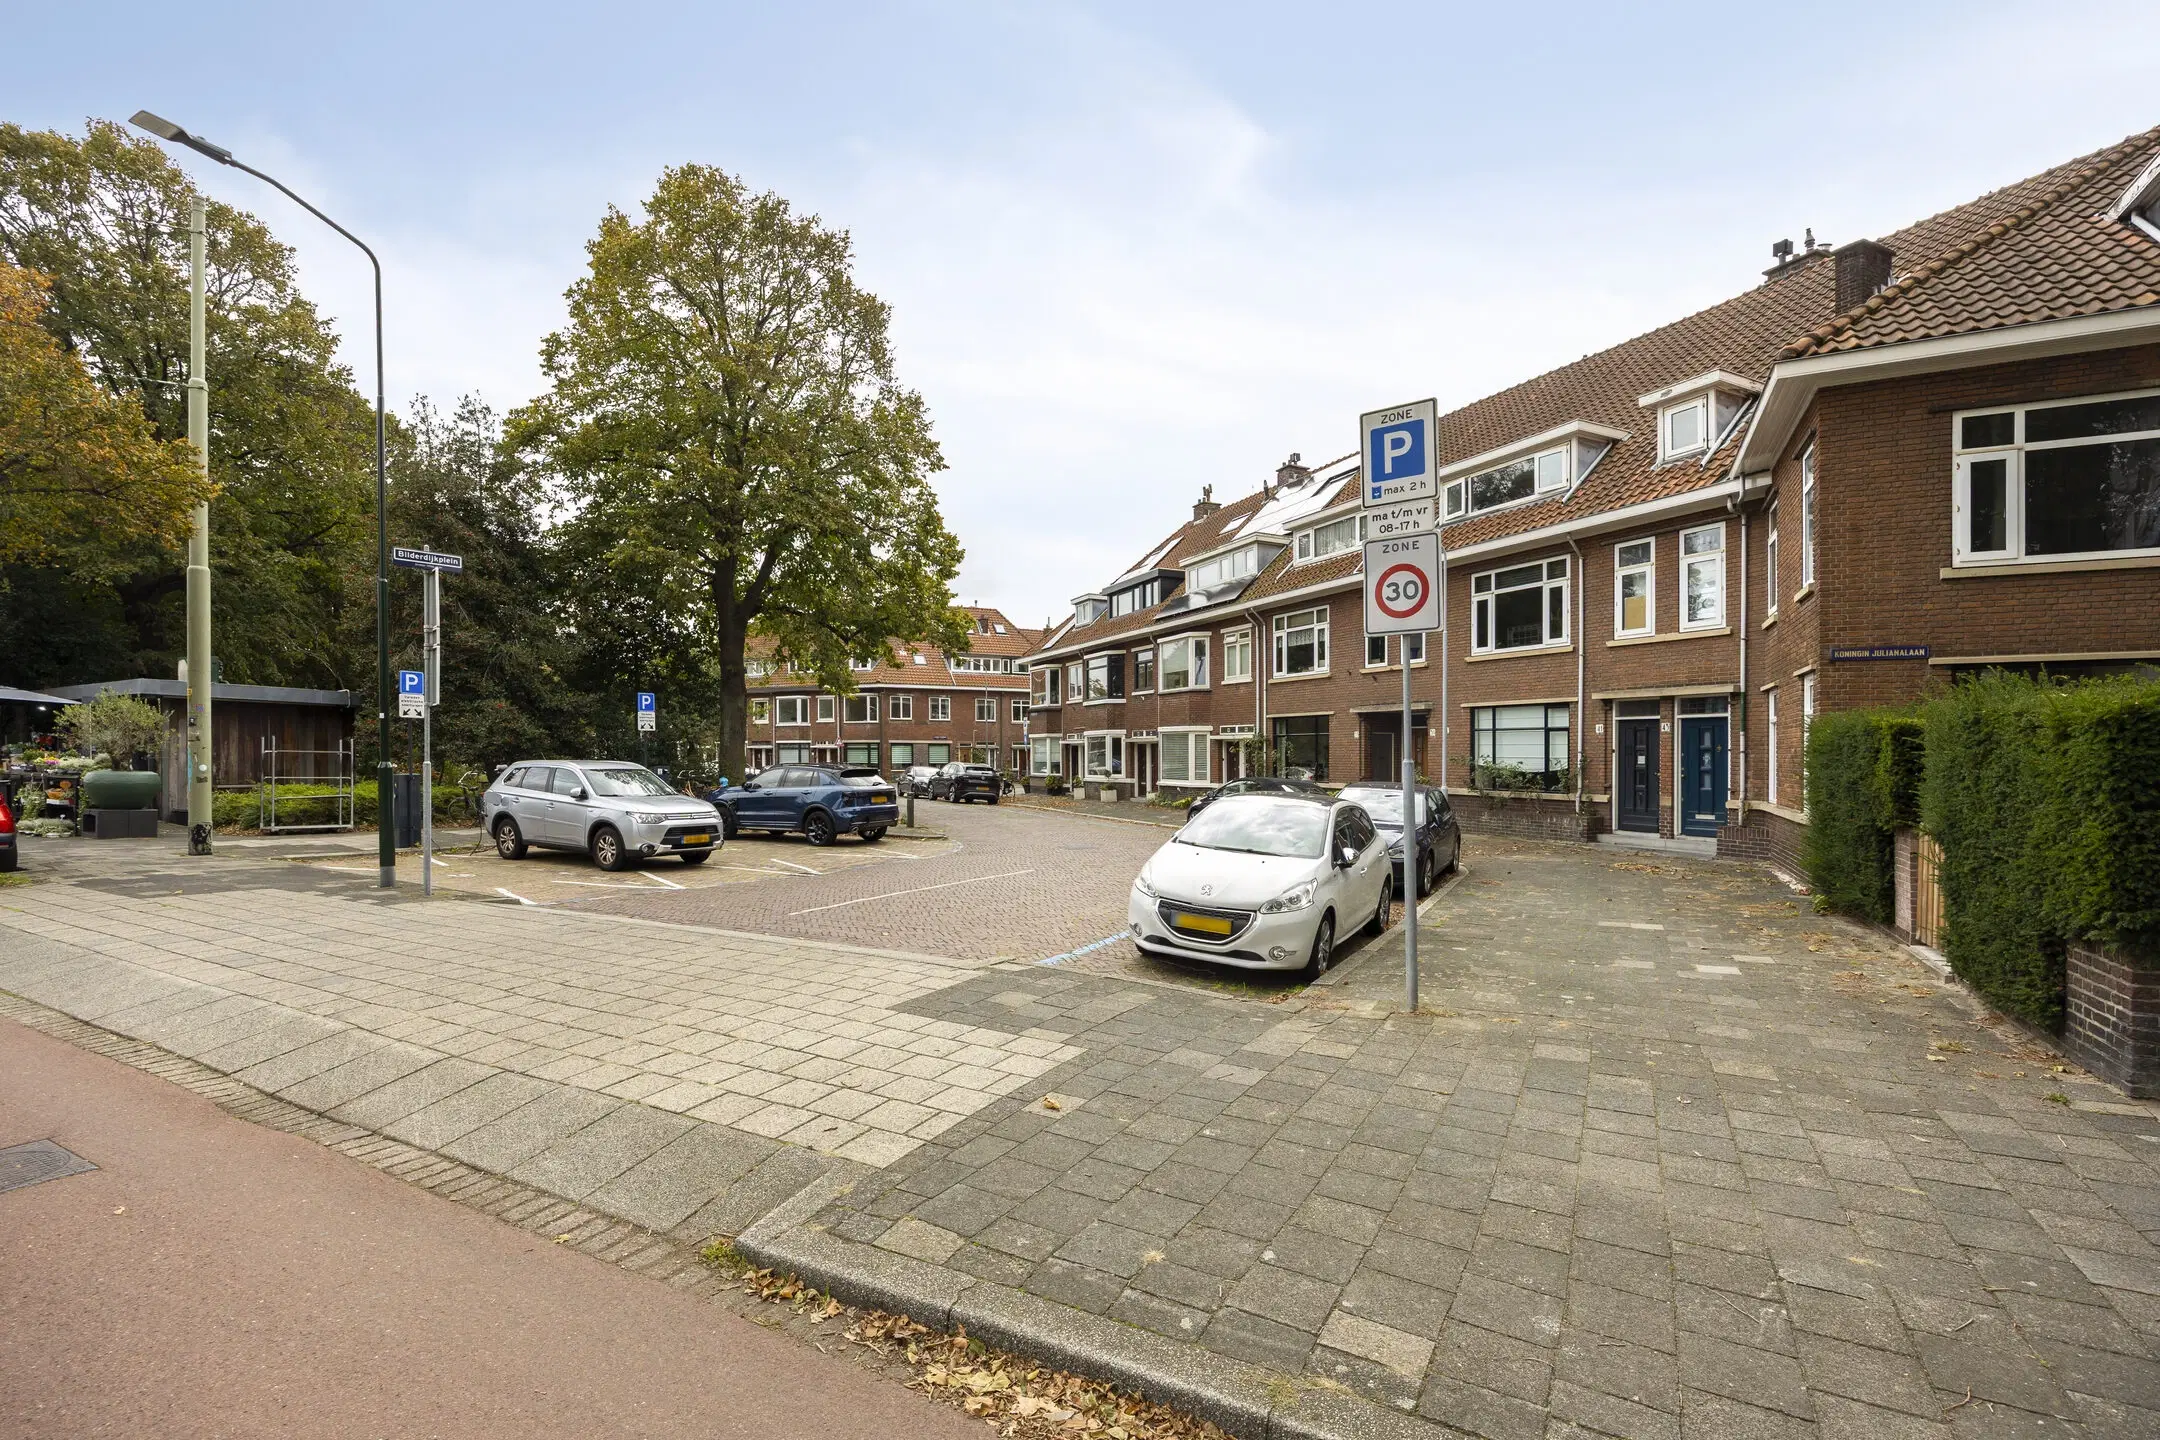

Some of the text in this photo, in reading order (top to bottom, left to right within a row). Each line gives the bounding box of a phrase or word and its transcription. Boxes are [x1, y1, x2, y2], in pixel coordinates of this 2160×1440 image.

[1381, 409, 1413, 424] ZONE
[1383, 430, 1413, 474] P
[1384, 481, 1426, 495] max 2 h
[1372, 506, 1428, 522] ma t/m vr
[1379, 520, 1420, 534] 08-17 h
[1382, 540, 1420, 554] ZONE
[398, 550, 459, 565] Bilderdijkplein
[1385, 579, 1420, 603] 30
[1834, 648, 1925, 658] KONINGIN JULIANALAAN
[405, 673, 419, 692] P
[642, 695, 651, 710] P
